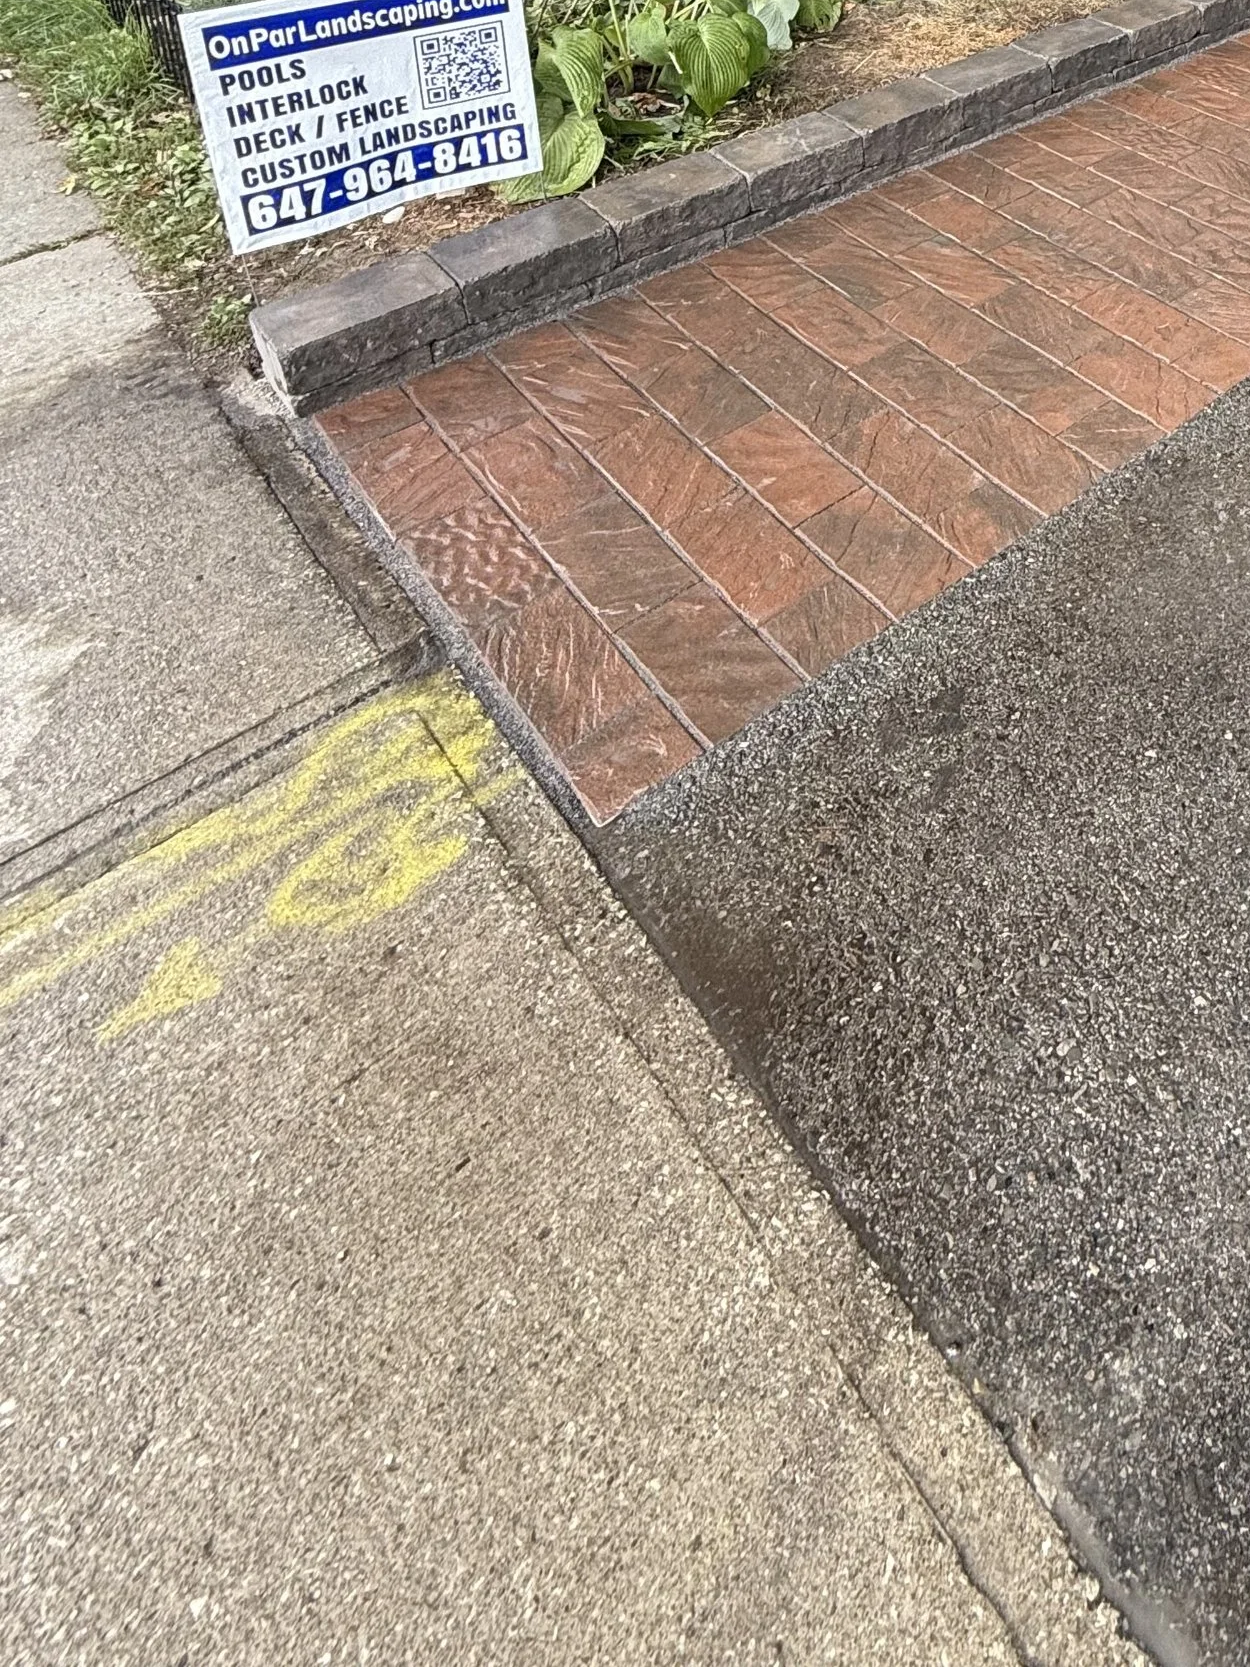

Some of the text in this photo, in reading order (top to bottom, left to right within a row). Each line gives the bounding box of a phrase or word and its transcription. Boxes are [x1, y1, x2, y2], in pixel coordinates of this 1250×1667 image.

[219, 59, 306, 96] POOLS
[226, 75, 368, 128] INTERLOCK
[234, 96, 409, 159] DECK / FENCE
[241, 102, 517, 188] CUSTOM LANDSCAPING
[248, 128, 523, 231] 647-964-8416
